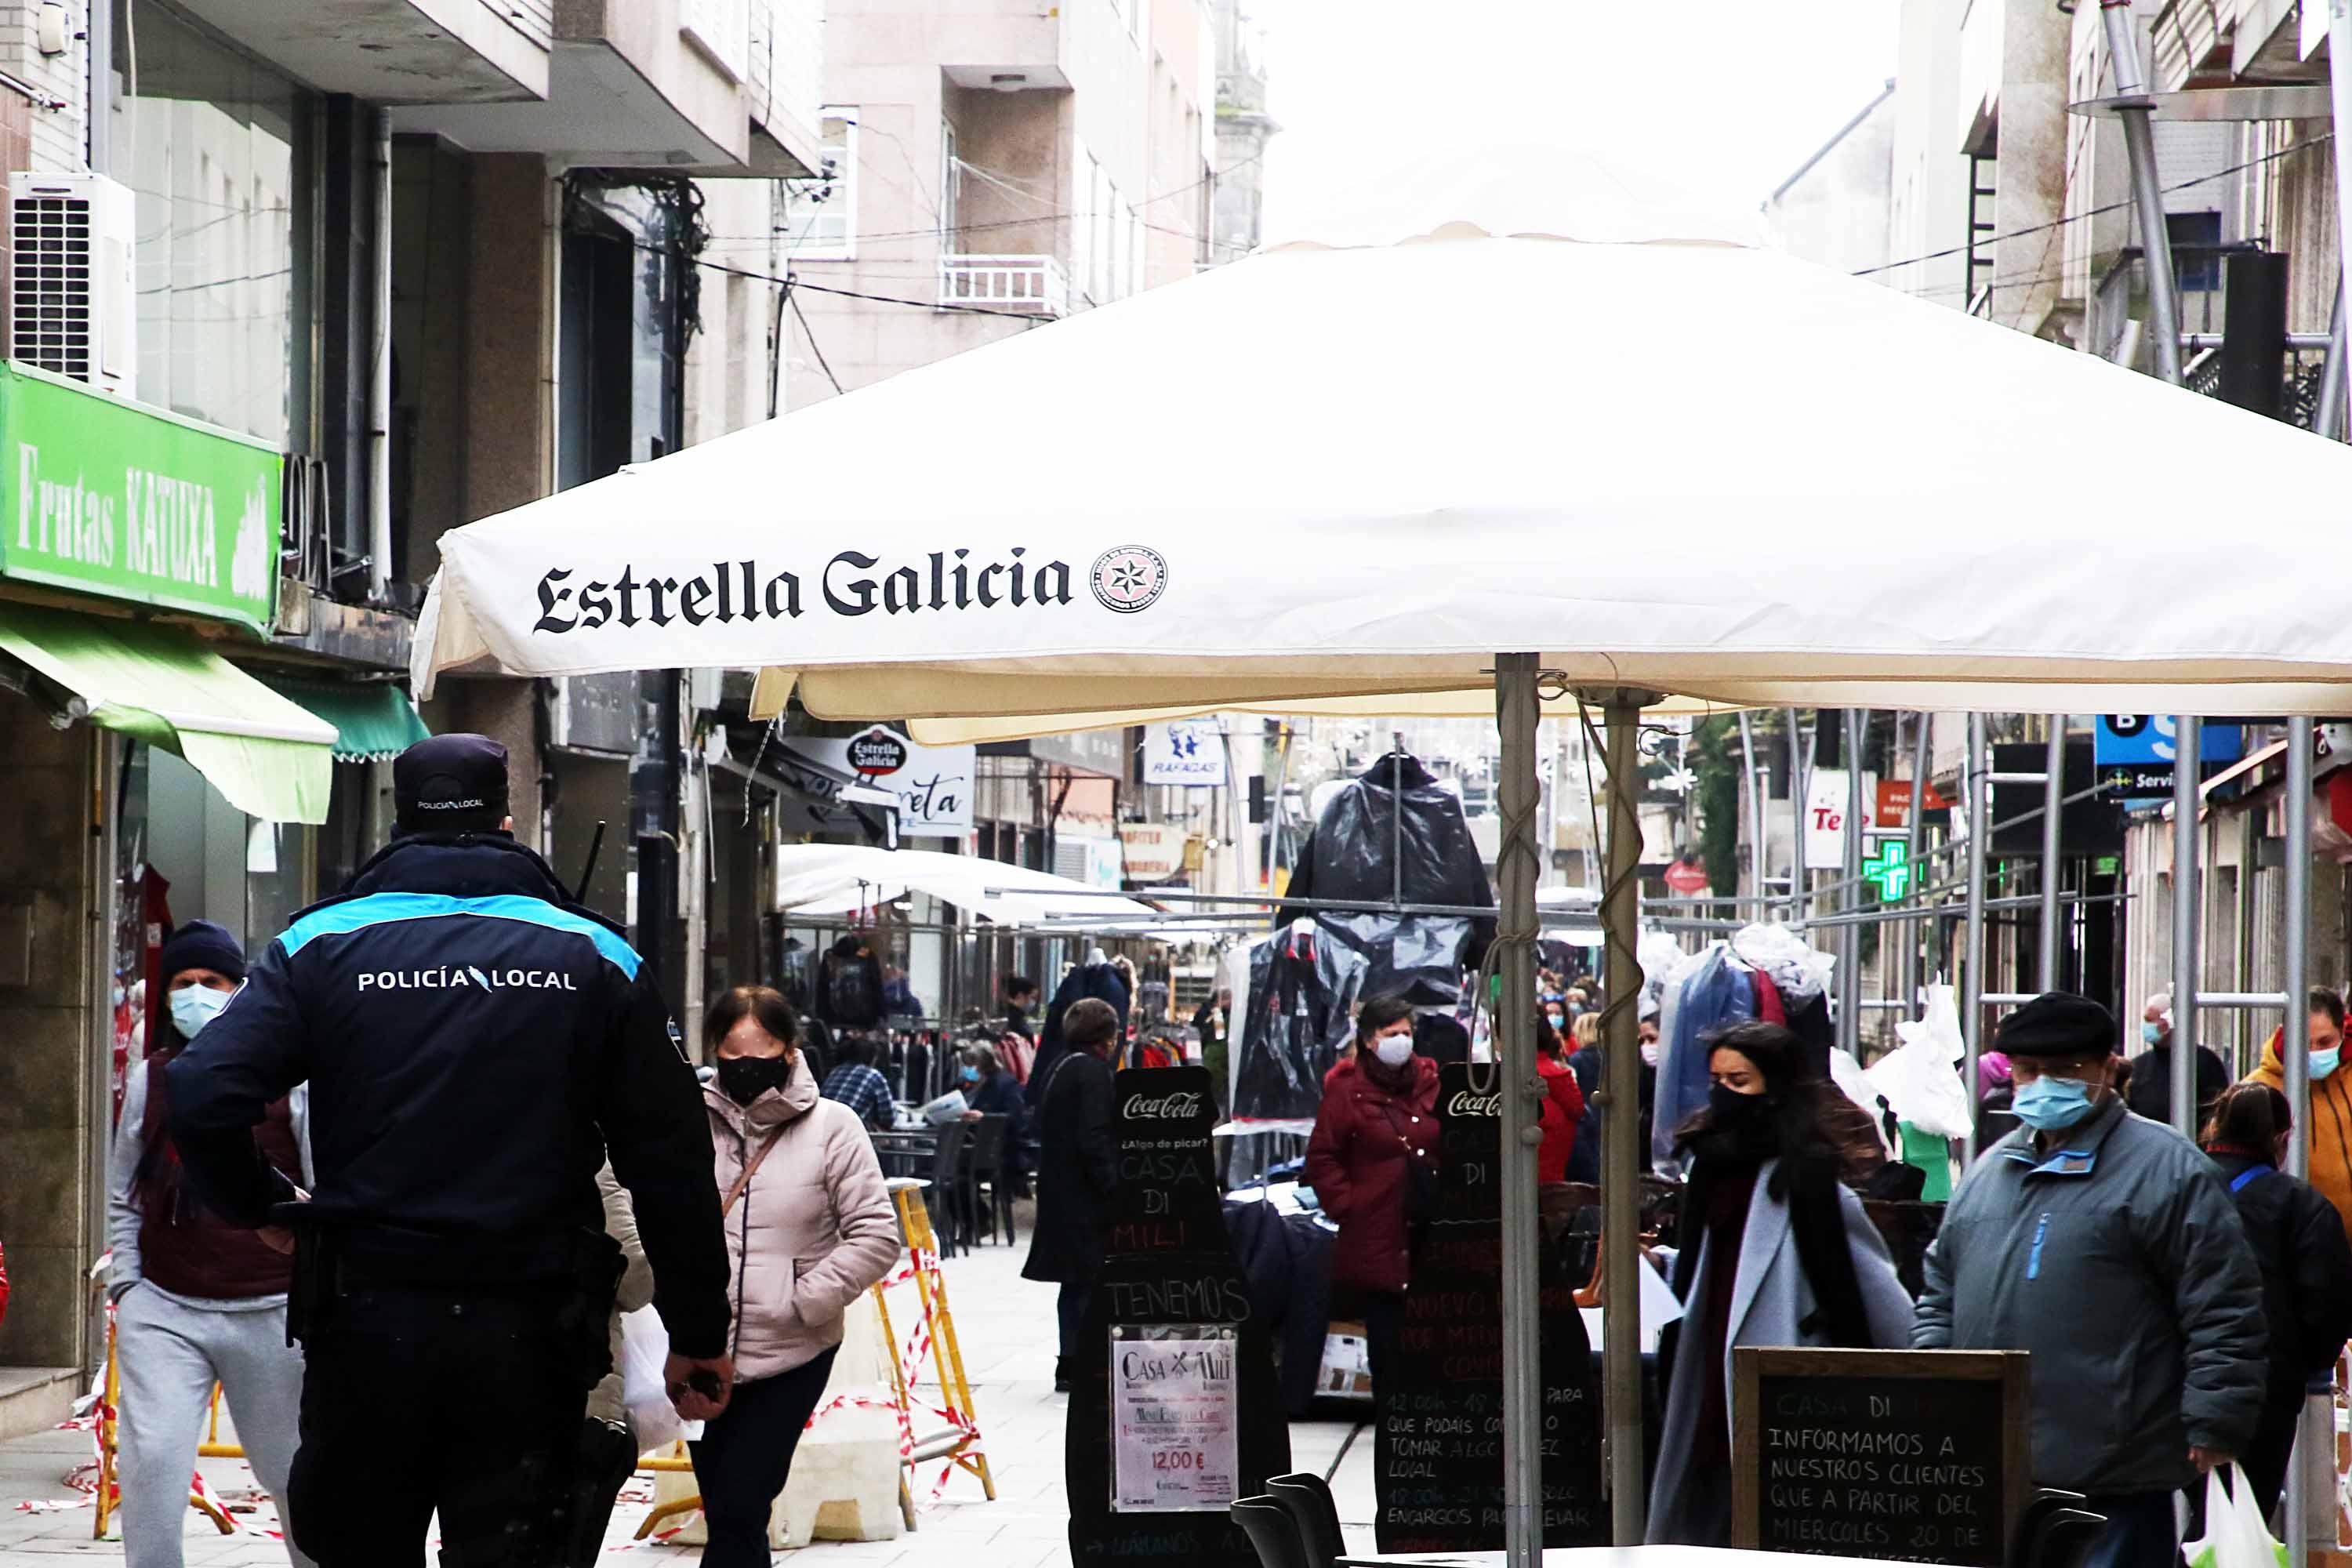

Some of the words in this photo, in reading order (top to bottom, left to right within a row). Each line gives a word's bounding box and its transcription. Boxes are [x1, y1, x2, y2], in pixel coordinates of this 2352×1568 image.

[18, 441, 114, 568] Frutas
[125, 466, 219, 587] KATUXA
[534, 561, 804, 634] Estrella
[823, 546, 1073, 616] Galicia
[854, 742, 899, 754] Estrella
[855, 754, 897, 766] Galicia
[2136, 772, 2176, 788] Servi
[459, 799, 484, 808] LOCAL
[358, 965, 470, 992] POLICÍA
[492, 969, 577, 991] LOCAL
[1122, 1141, 1154, 1150] ¿Algo
[1157, 1140, 1171, 1149] de
[1174, 1138, 1208, 1149] picar?
[1120, 1154, 1204, 1185] CASA
[1462, 1162, 1486, 1185] DI
[1142, 1188, 1170, 1214] DI
[1112, 1217, 1186, 1250] MILI
[1103, 1275, 1251, 1323] TENEMOS
[1546, 1388, 1584, 1404] PARA
[1869, 1395, 1891, 1417] DI
[1387, 1417, 1415, 1434] QUE
[1390, 1438, 1443, 1457] TOMAR
[1769, 1428, 1923, 1455] INFORMAMOS
[1939, 1436, 1955, 1455] A
[1152, 1451, 1192, 1472] 12,00
[1196, 1453, 1205, 1469] €
[1771, 1459, 1879, 1480] NUESTROS
[1889, 1463, 1984, 1486] CLIENTES
[1770, 1485, 1813, 1508] QUE
[1821, 1490, 1838, 1508] A
[1848, 1489, 1920, 1514] PARTIR
[1937, 1494, 1976, 1515] DEL
[1387, 1507, 1472, 1526] ENCARGOS
[1908, 1526, 1940, 1548] 20
[1954, 1530, 1982, 1547] DE
